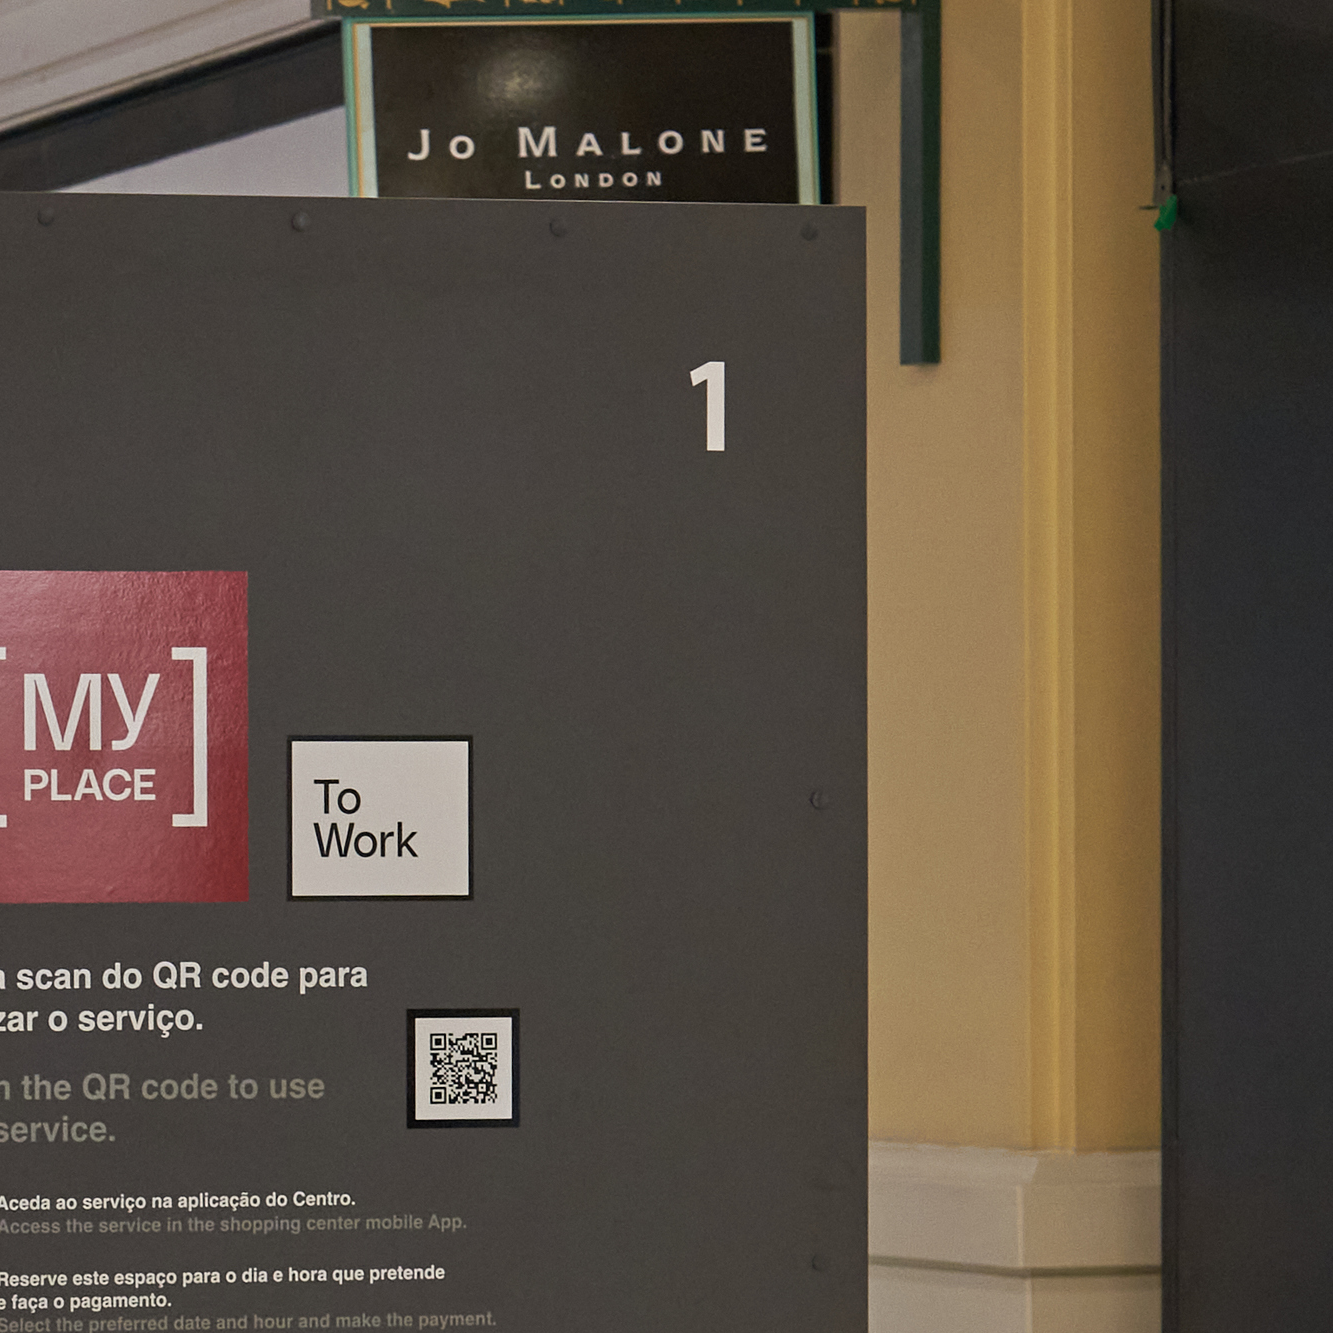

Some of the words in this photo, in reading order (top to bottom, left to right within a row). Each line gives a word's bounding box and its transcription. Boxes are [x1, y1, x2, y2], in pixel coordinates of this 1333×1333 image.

[690, 361, 725, 451] 1
[23, 768, 156, 802] PLACE
[314, 779, 361, 815] To
[314, 822, 418, 858] Work
[17, 969, 91, 990] scan
[103, 962, 142, 989] do
[153, 961, 201, 989] QR
[212, 962, 288, 988] code
[300, 967, 367, 994] para
[48, 1011, 67, 1031] o
[78, 1004, 202, 1038] serviço.
[21, 1074, 71, 1100] the
[83, 1073, 130, 1100] QR
[142, 1073, 218, 1100] code
[228, 1075, 258, 1099] to
[270, 1079, 324, 1098] use
[56, 1198, 77, 1210] ao
[83, 1194, 146, 1213] serviço
[152, 1197, 172, 1208] na
[178, 1192, 260, 1211] aplicação
[266, 1192, 287, 1206] do
[293, 1191, 355, 1206] Centro.
[66, 1219, 93, 1232] the
[99, 1217, 161, 1232] service
[167, 1217, 182, 1231] in
[188, 1217, 215, 1231] the
[220, 1216, 300, 1234] shopping
[307, 1216, 360, 1230] center
[366, 1215, 423, 1229] mobile
[428, 1214, 466, 1232] App.
[73, 1271, 109, 1285] este
[114, 1273, 177, 1288] espaço
[183, 1272, 220, 1287] para
[226, 1271, 236, 1283] o
[242, 1268, 267, 1282] dia
[273, 1271, 283, 1282] e
[289, 1267, 327, 1281] hora
[333, 1269, 364, 1284] que
[370, 1265, 445, 1284] pretende
[12, 1294, 47, 1313] faça
[54, 1297, 64, 1308] o
[70, 1293, 171, 1312] pagamento.
[56, 1317, 83, 1332] the
[174, 1315, 210, 1330] date
[216, 1315, 247, 1329] and
[254, 1314, 293, 1328] hour
[299, 1314, 330, 1328] and
[336, 1313, 381, 1327] make
[387, 1313, 413, 1326] the
[419, 1312, 496, 1330] payment.
